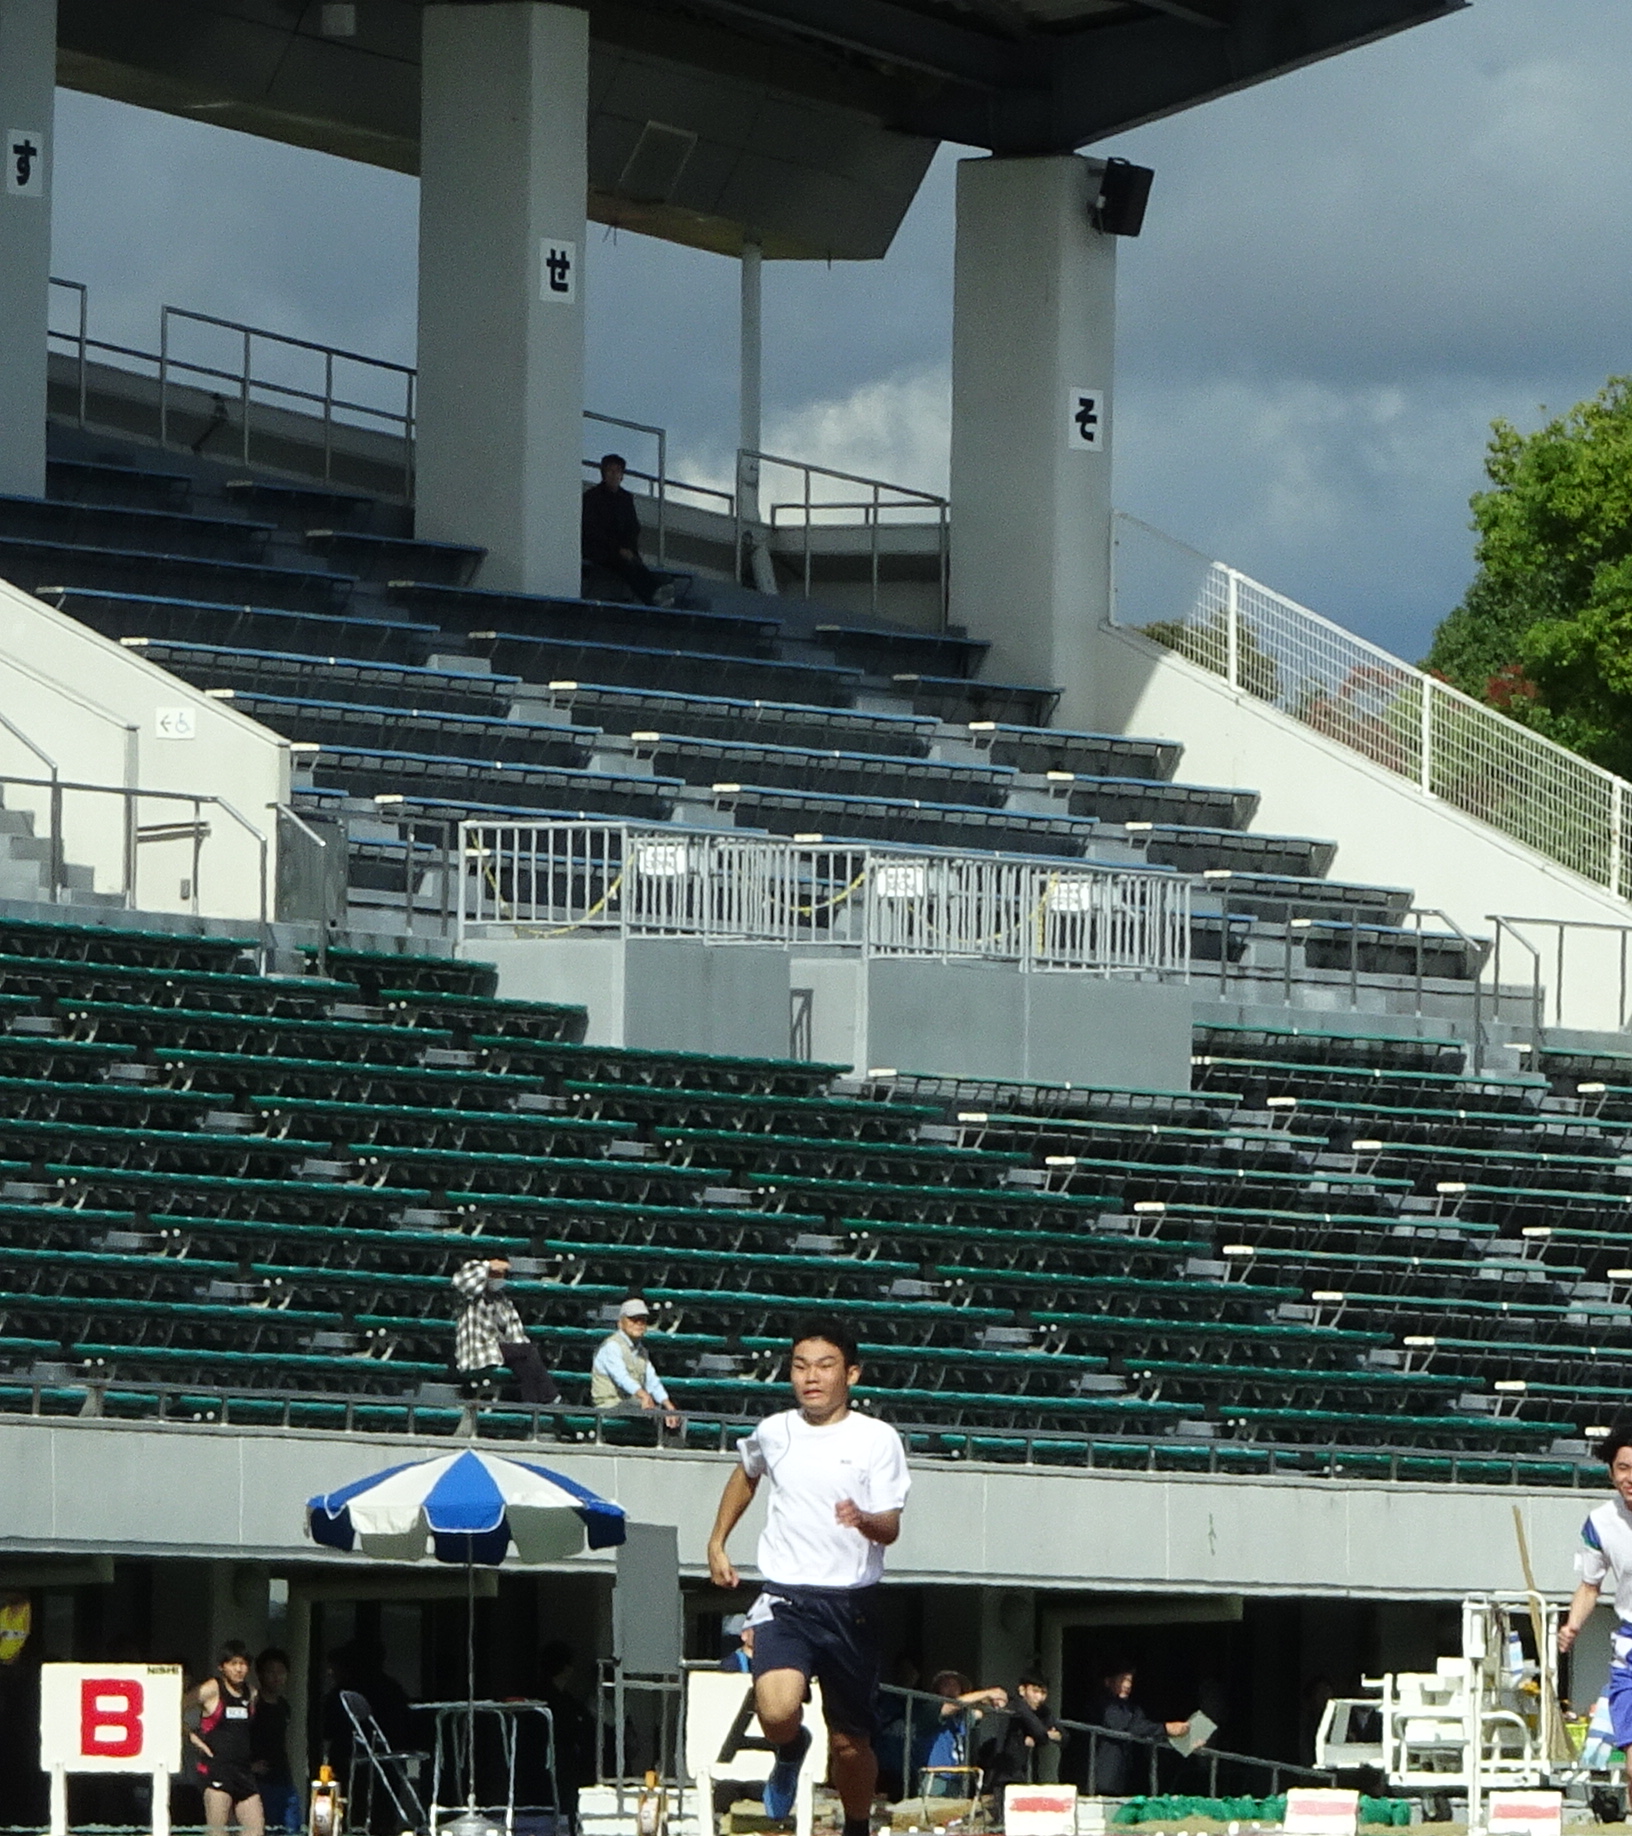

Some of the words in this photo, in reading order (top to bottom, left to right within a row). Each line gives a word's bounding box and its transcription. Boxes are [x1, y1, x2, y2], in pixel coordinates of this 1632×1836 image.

[13, 139, 37, 187] す
[546, 248, 570, 293] せ
[1075, 397, 1097, 442] そ
[80, 1678, 144, 1758] B
